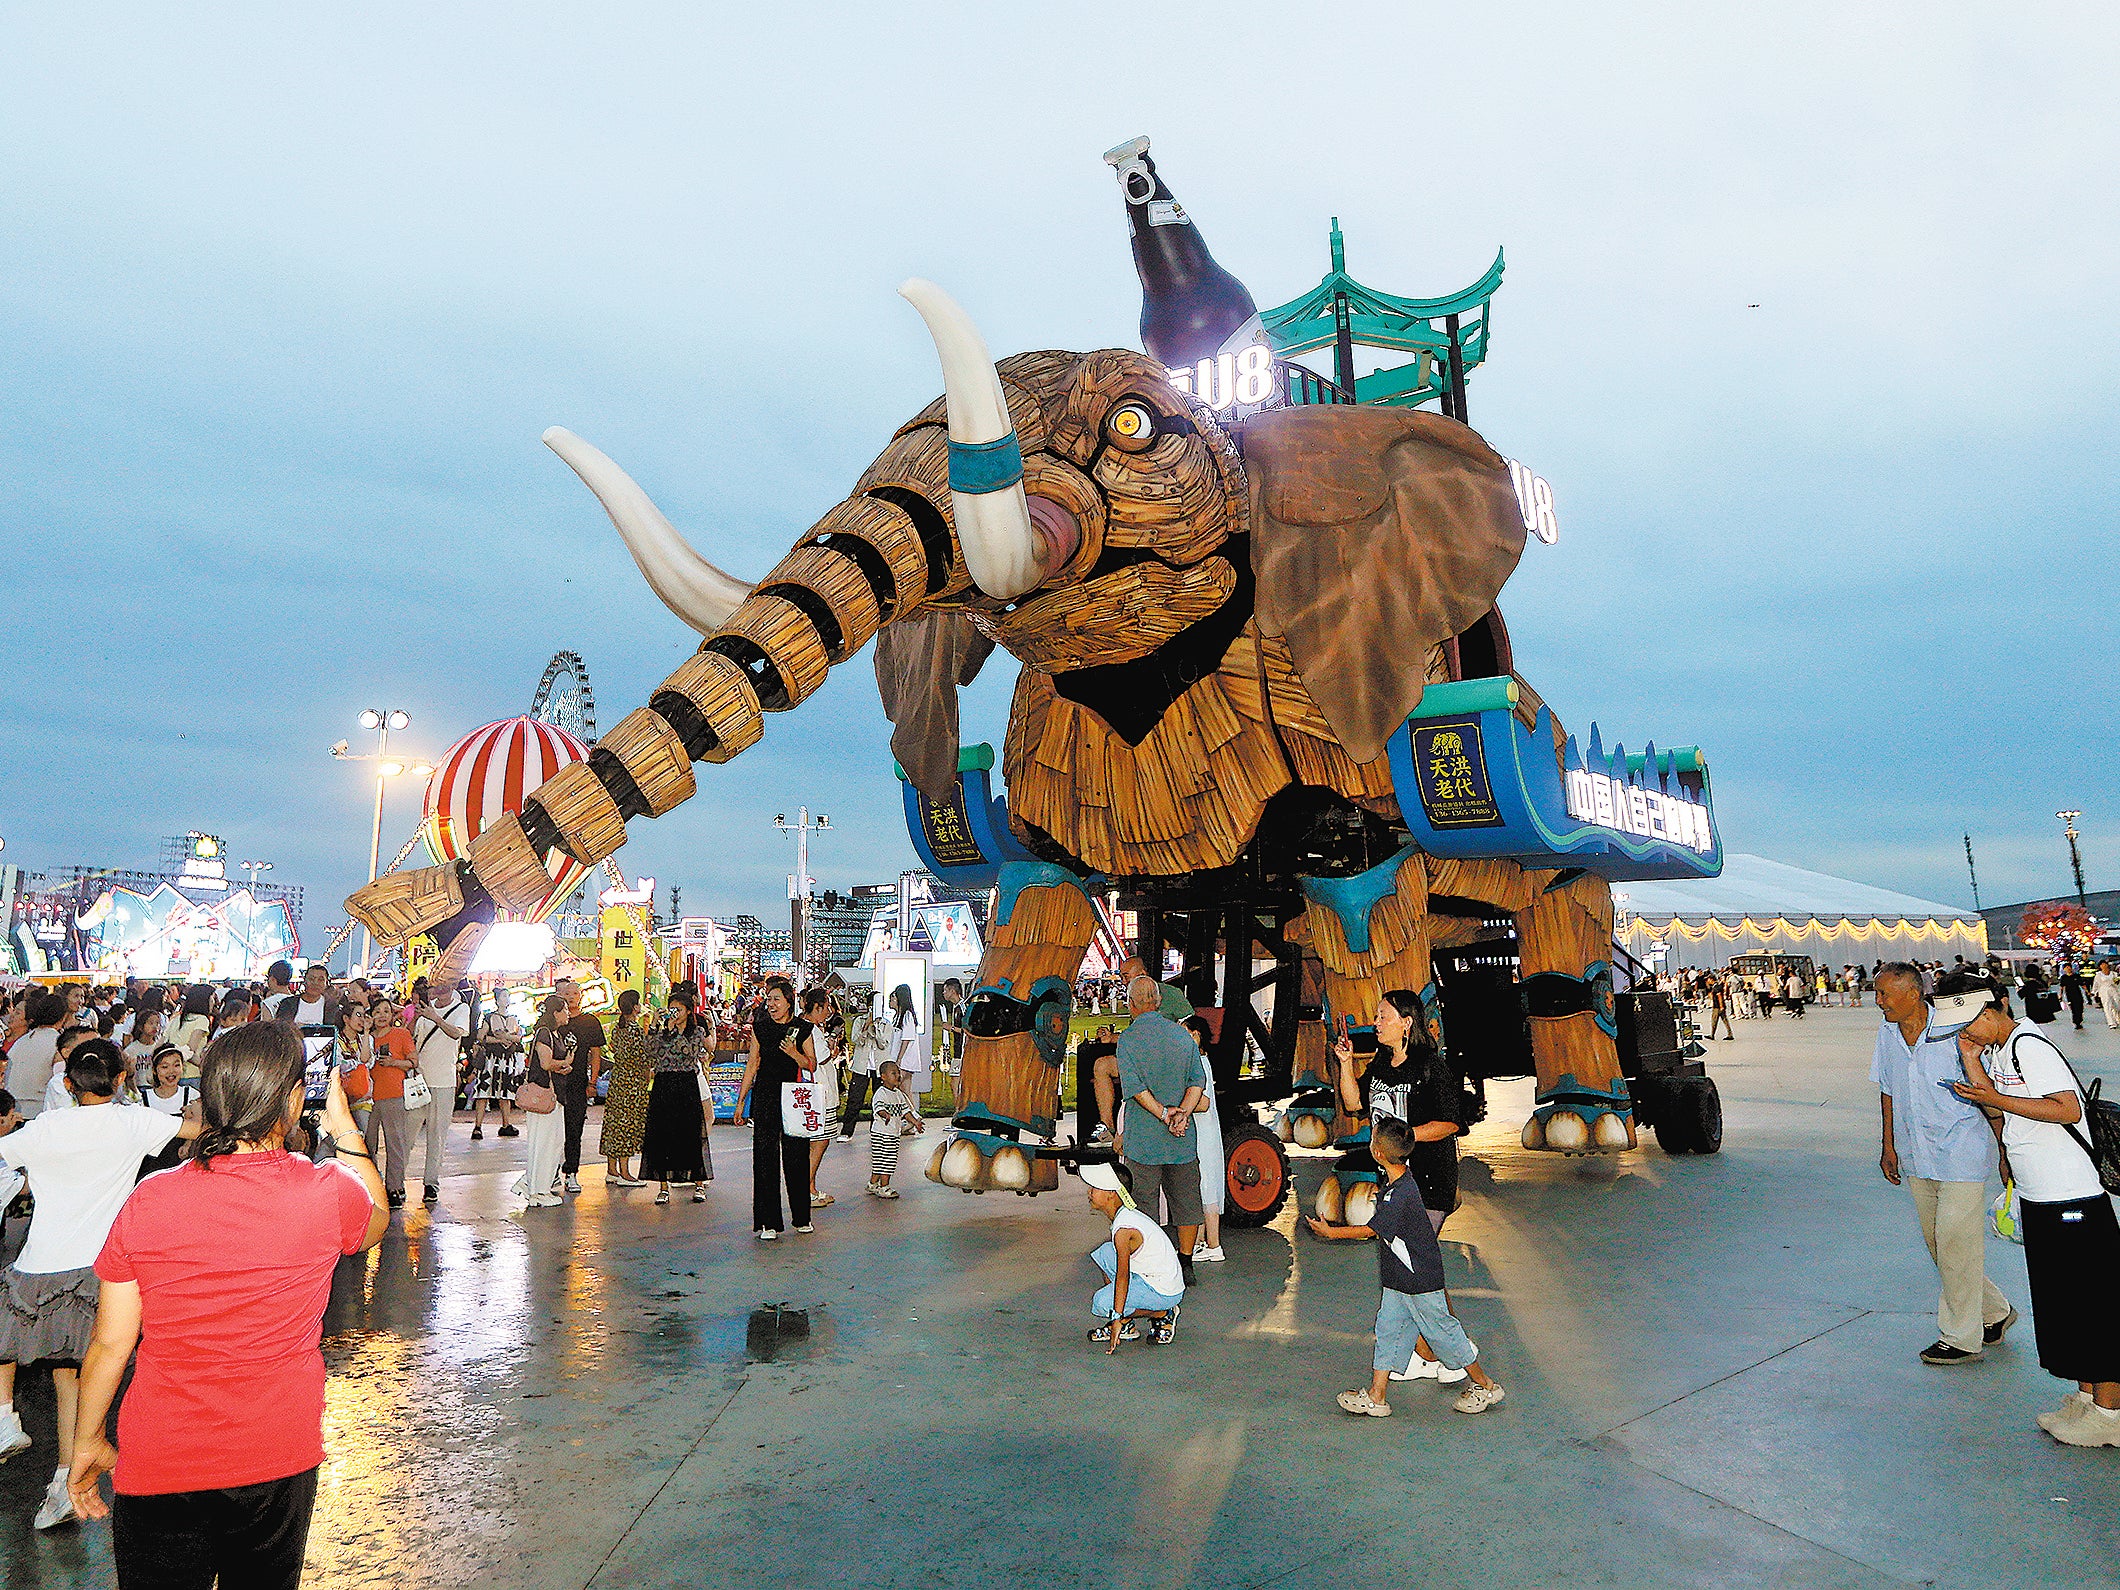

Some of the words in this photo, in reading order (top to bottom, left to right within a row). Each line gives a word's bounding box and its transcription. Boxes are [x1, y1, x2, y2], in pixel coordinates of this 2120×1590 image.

[1508, 457, 1558, 545] U8
[1429, 755, 1472, 779] 天洪
[1433, 777, 1477, 799] 老代
[1565, 768, 1712, 854] 中国人自己
[613, 930, 633, 982] 世界
[791, 1087, 823, 1132] 驚喜
